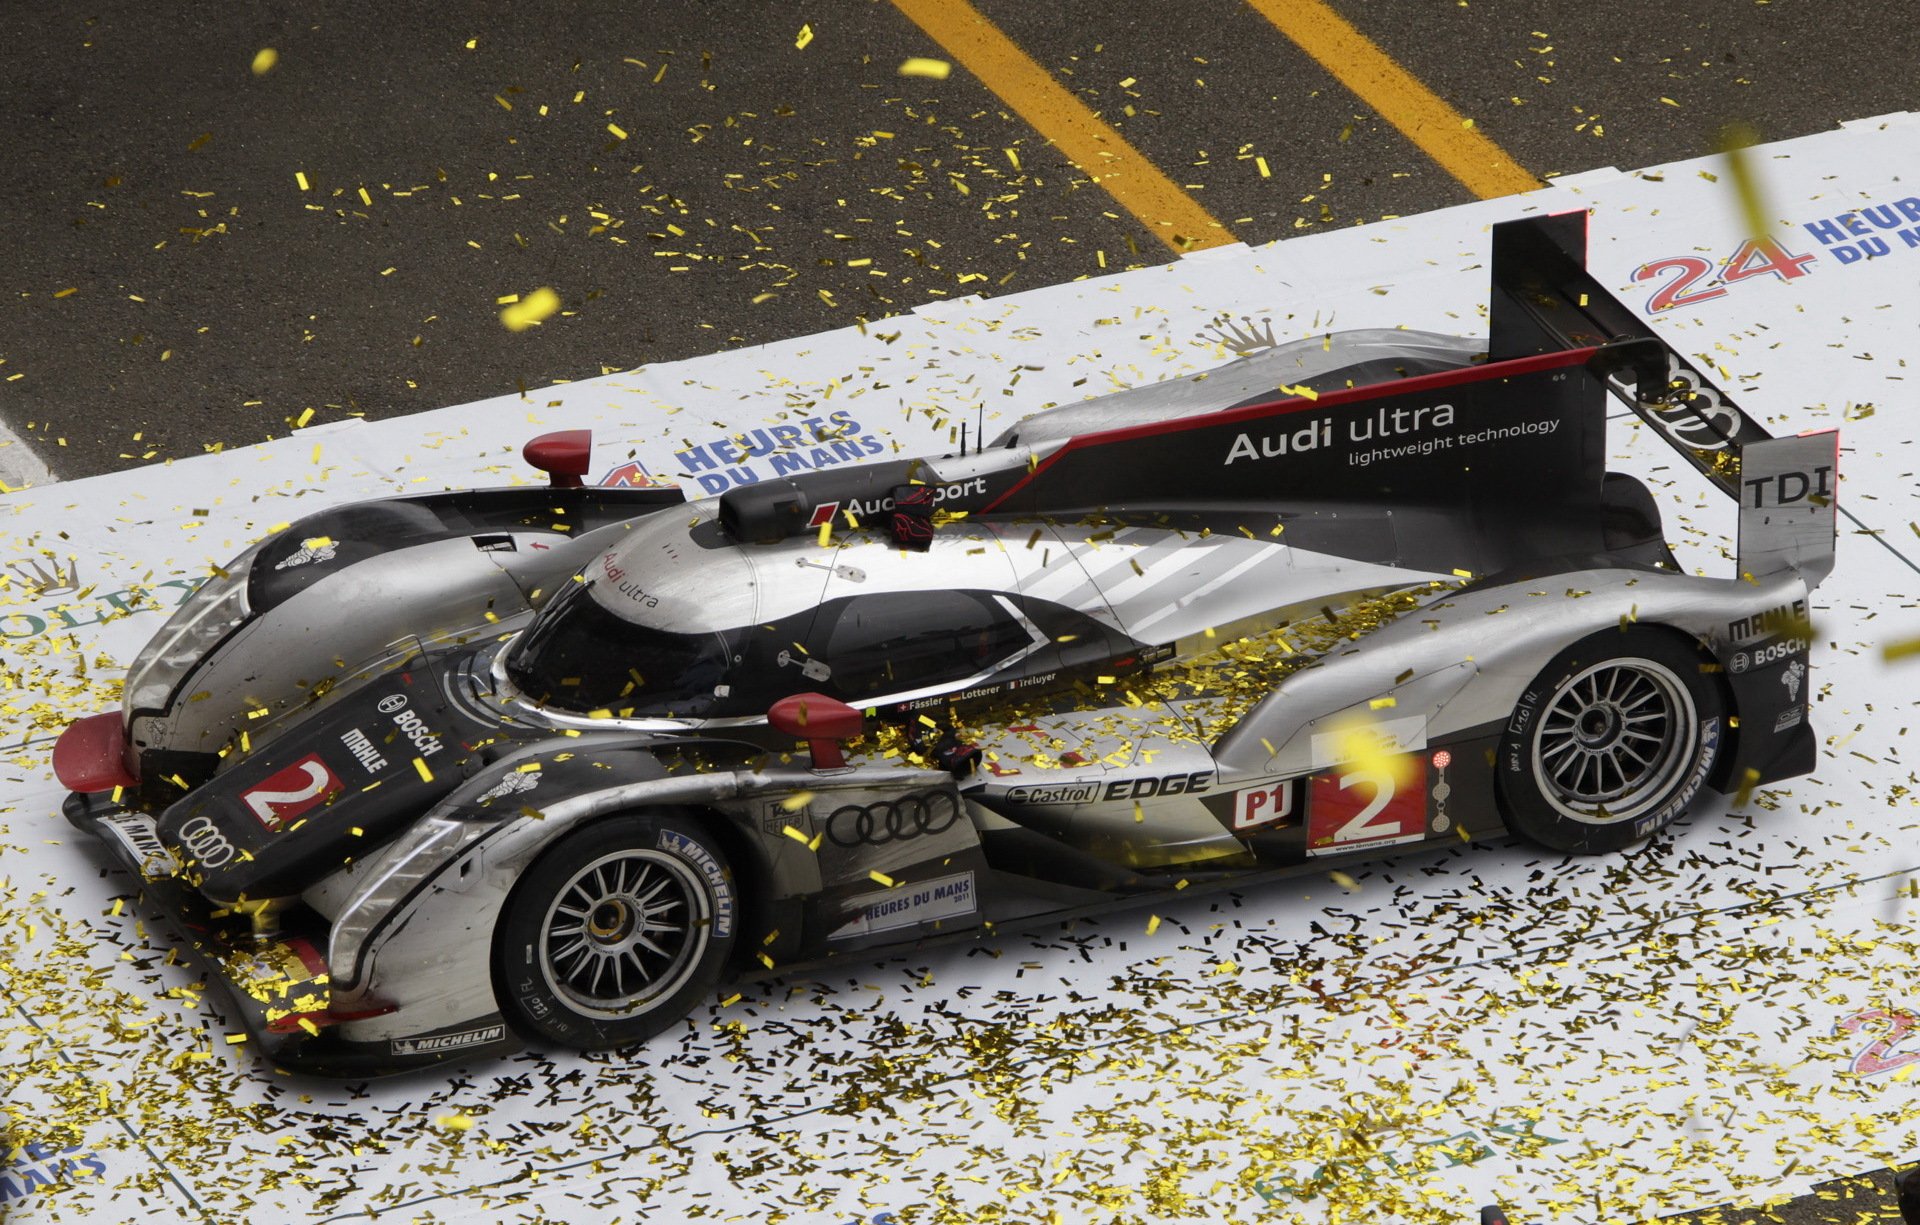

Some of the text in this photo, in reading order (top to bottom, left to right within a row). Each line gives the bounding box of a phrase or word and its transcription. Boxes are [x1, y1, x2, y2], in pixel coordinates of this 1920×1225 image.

[1630, 234, 1818, 314] 24
[1829, 236, 1892, 265] DU
[674, 410, 862, 474] HEURES
[1224, 403, 1455, 466] Audi ultra
[1349, 418, 1560, 467] lightweight technology
[705, 466, 759, 495] DU
[772, 434, 884, 479] MANS
[1745, 466, 1832, 509] TDI
[931, 478, 986, 508] port
[603, 552, 659, 609] Audi ultra
[1755, 637, 1806, 665] BOSCH
[962, 686, 1000, 700] Lotterer
[1019, 672, 1057, 688] Tréluyer
[341, 728, 388, 774] MAHLE
[393, 709, 443, 757] BOSCH
[244, 760, 329, 826] 2
[1031, 770, 1215, 805] Castrol EDGE
[1246, 783, 1284, 820] P1
[1334, 770, 1401, 843] 2
[1639, 743, 1719, 837] MICHELIN
[121, 824, 169, 861] MANS
[682, 841, 733, 935] MICHELIN
[865, 880, 970, 920] HEURES DU MANS
[417, 1028, 501, 1050] MICHELIN
